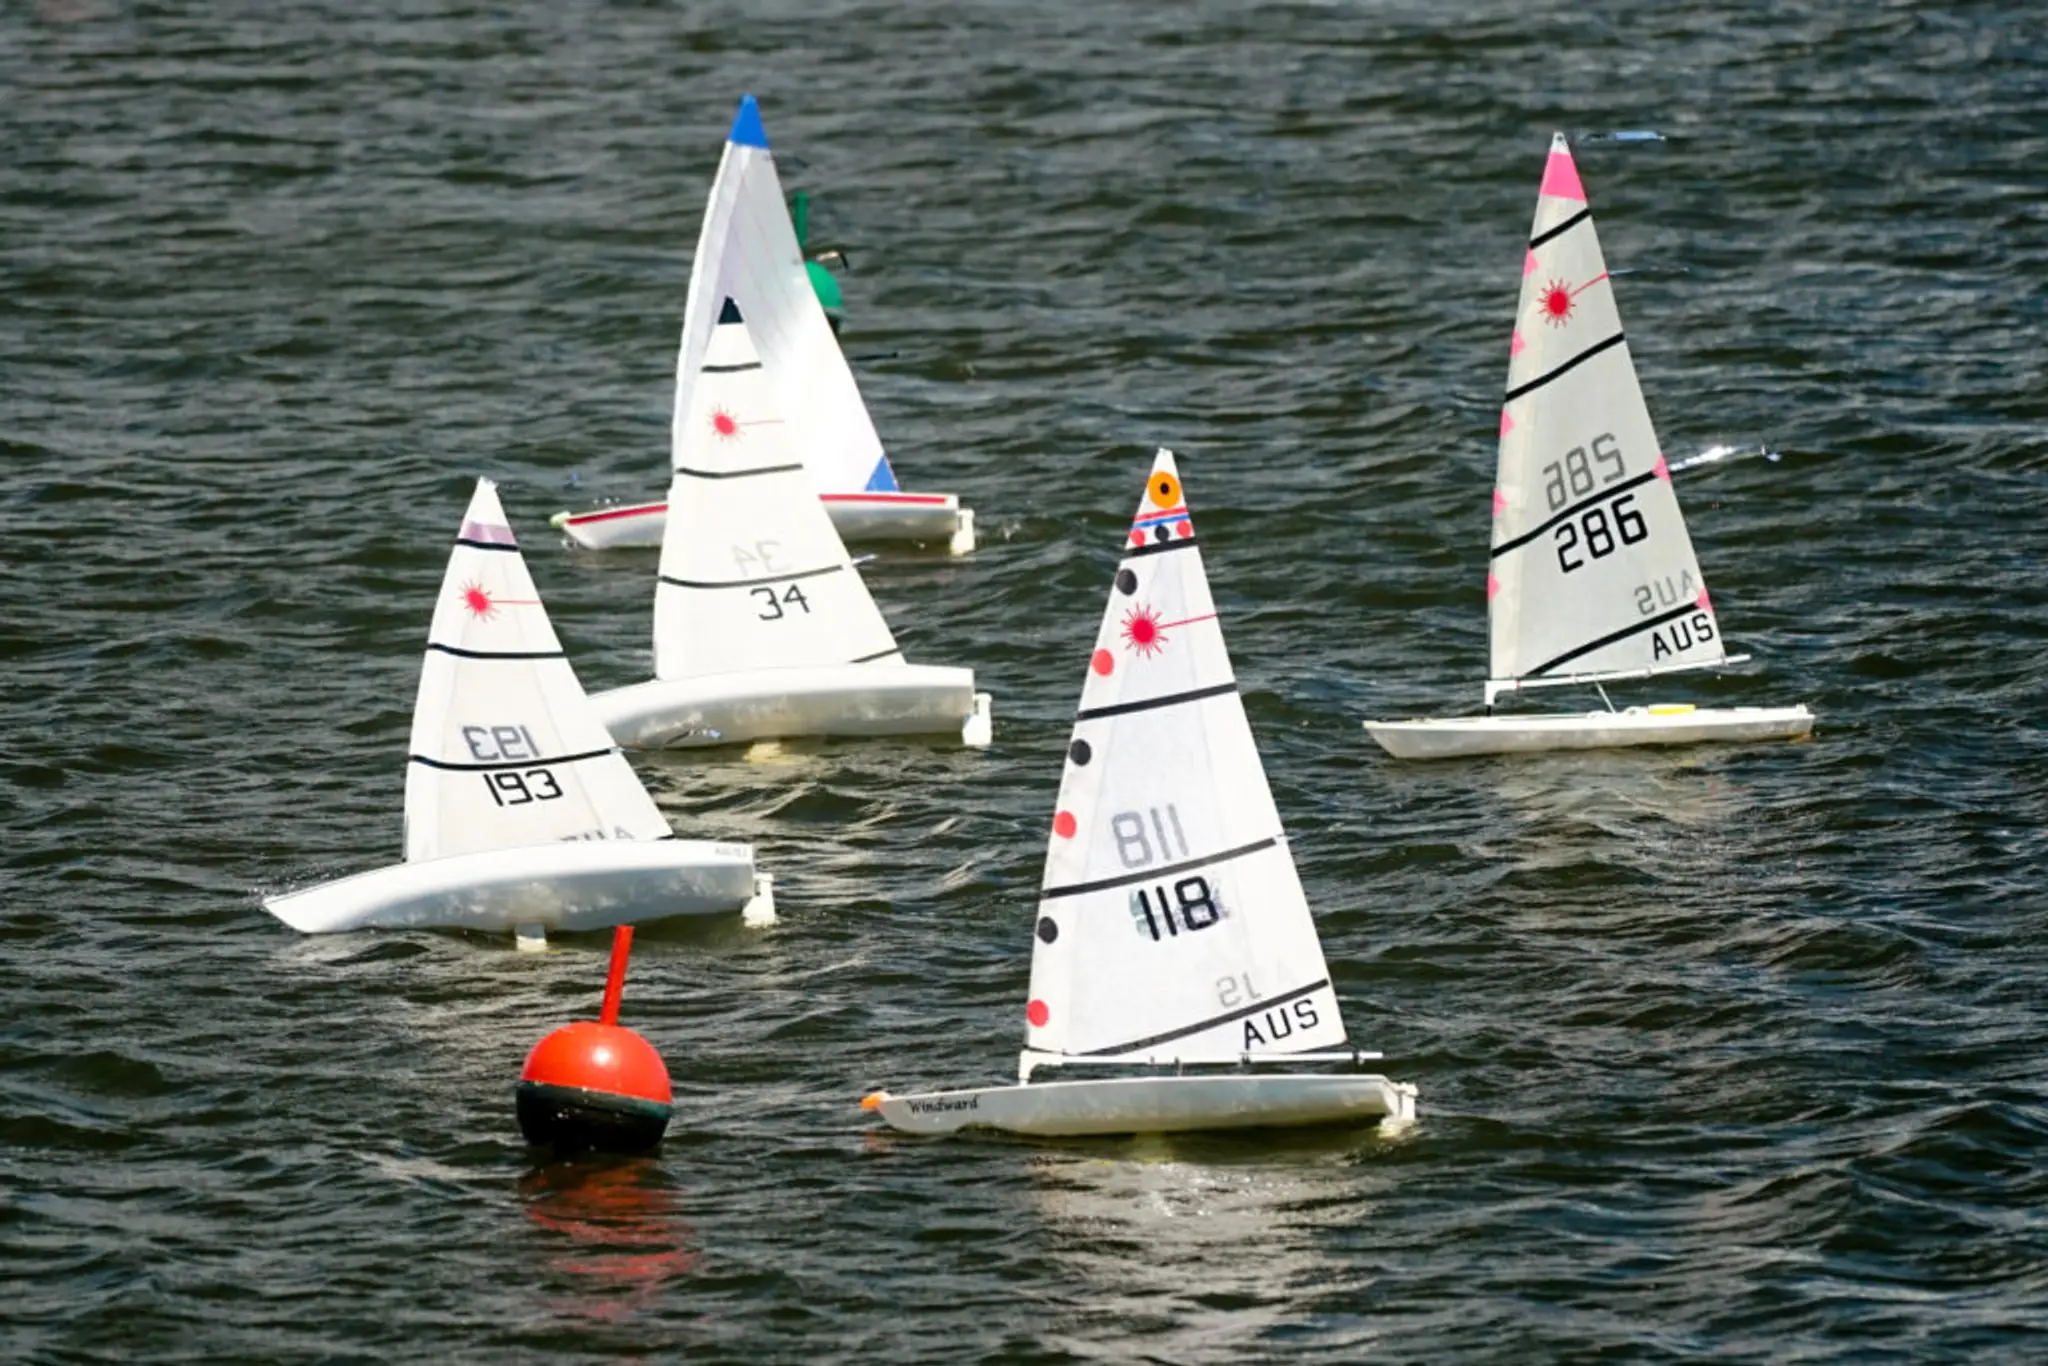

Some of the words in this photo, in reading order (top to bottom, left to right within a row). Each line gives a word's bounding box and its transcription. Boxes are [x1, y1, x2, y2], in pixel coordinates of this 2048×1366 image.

[1554, 494, 1648, 573] 286
[750, 583, 810, 620] 34
[1652, 612, 1713, 661] AUS
[483, 768, 563, 807] 193
[1137, 876, 1220, 941] 118
[1243, 998, 1319, 1051] AUS
[906, 1094, 979, 1114] Windward
